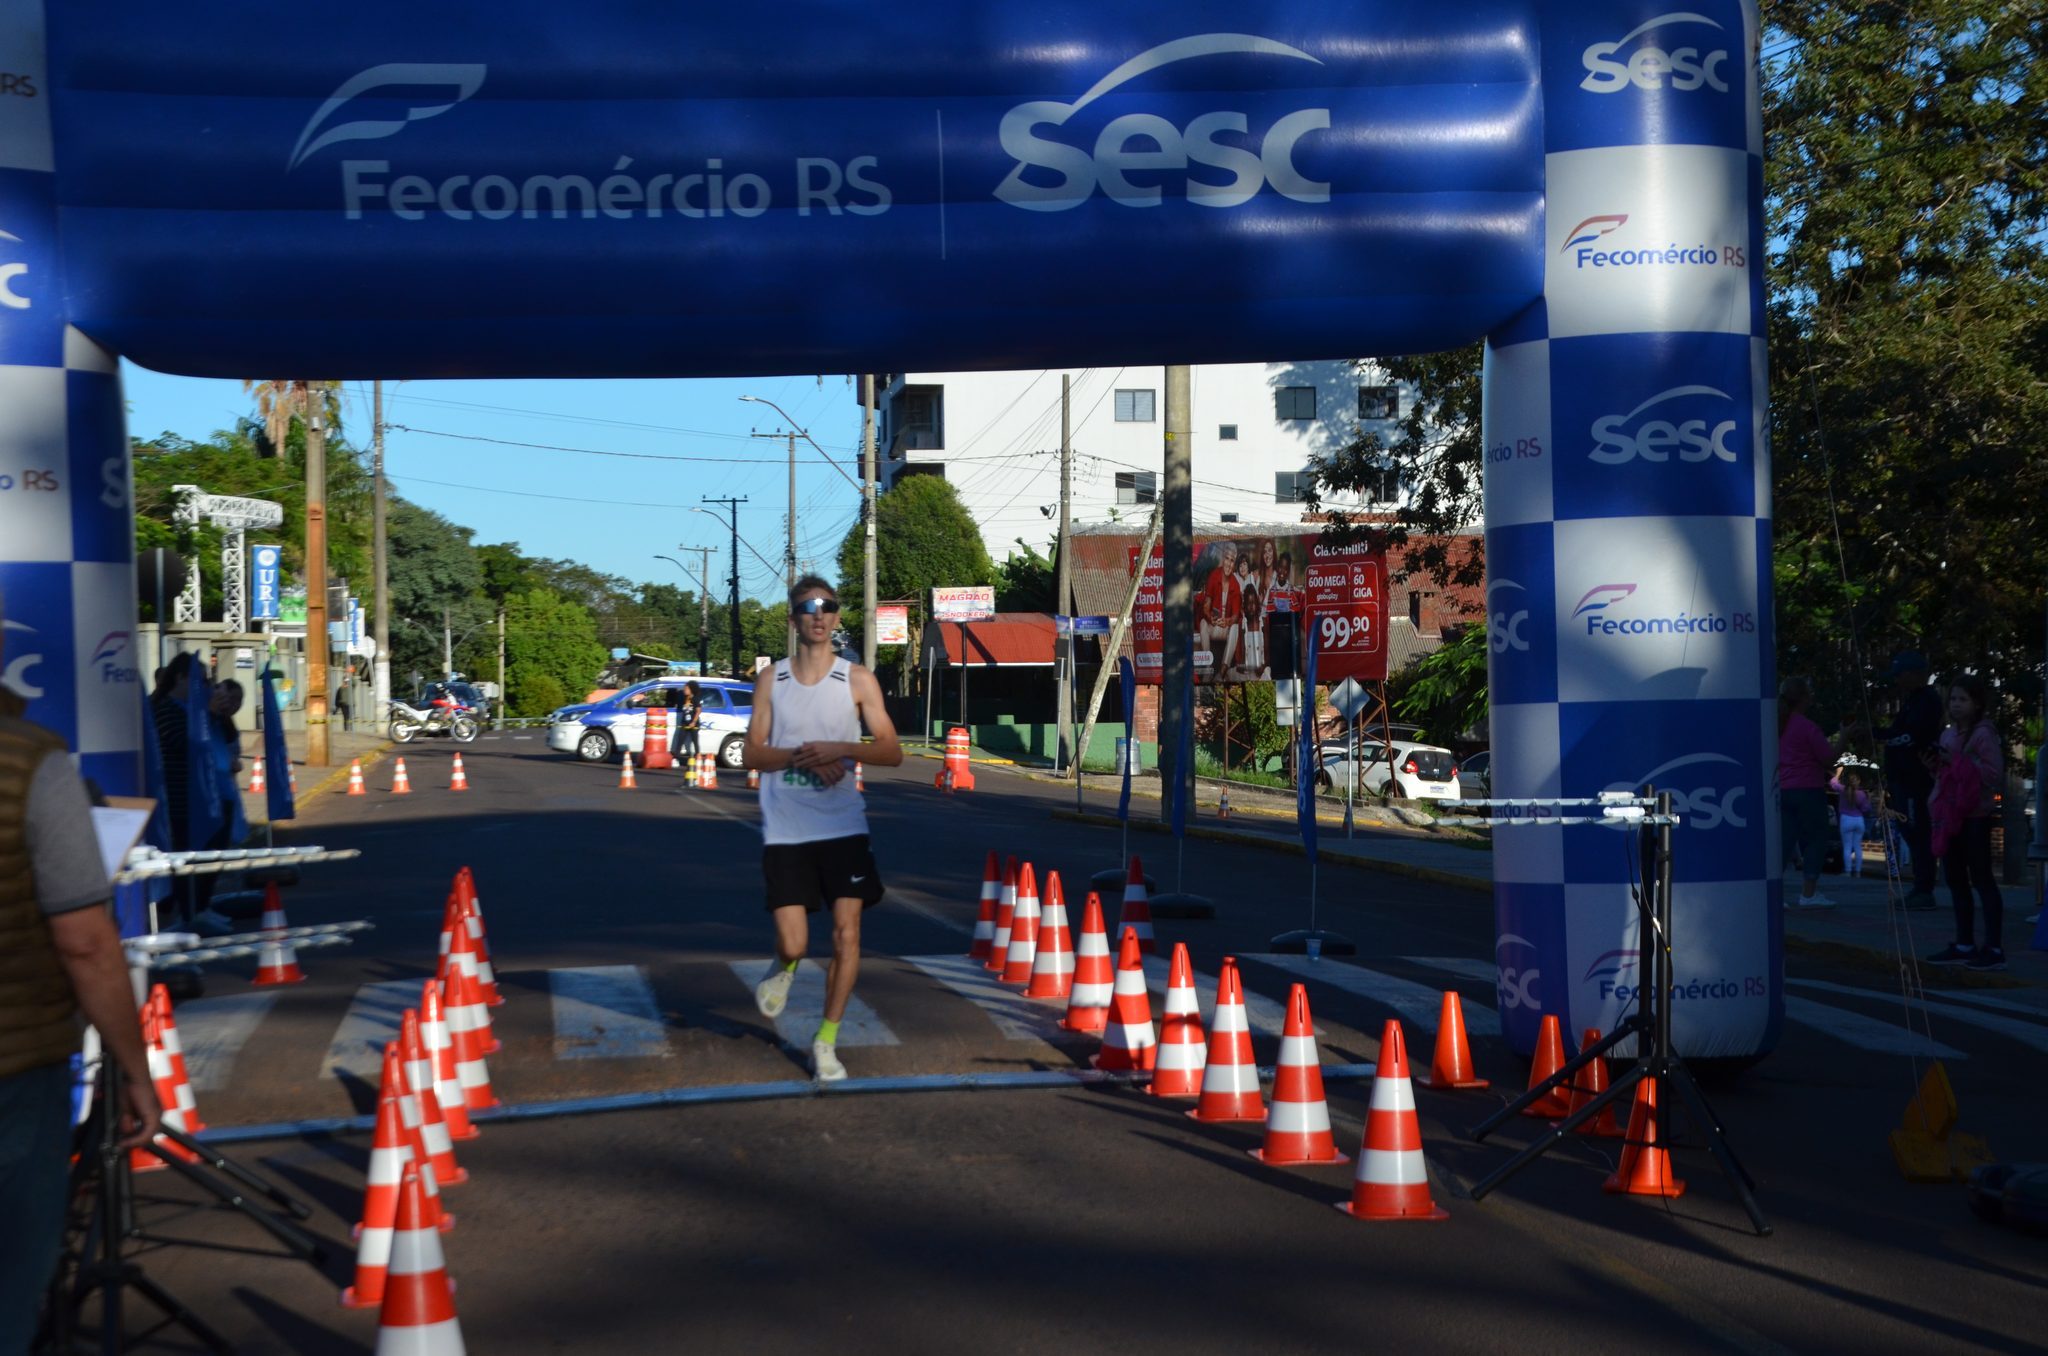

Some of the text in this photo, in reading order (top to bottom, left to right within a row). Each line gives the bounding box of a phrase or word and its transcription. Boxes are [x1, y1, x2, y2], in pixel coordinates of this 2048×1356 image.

[1580, 42, 1729, 93] Sesc
[992, 100, 1332, 212] Sesc
[341, 155, 893, 221] Fecomércio RS
[1577, 243, 1745, 269] Fecomércio RS
[1517, 437, 1542, 459] RS
[1587, 414, 1737, 465] Sesc
[22, 469, 59, 491] RS
[1308, 575, 1346, 588] 600 MEGA
[1353, 574, 1365, 585] 60
[258, 569, 276, 617] URI
[1353, 587, 1373, 598] GIGA
[1143, 611, 1154, 622] na
[1587, 612, 1754, 635] Fecomércio RS
[1136, 626, 1163, 641] cidade.
[1321, 616, 1370, 649] 99,90
[1744, 976, 1766, 997] RS
